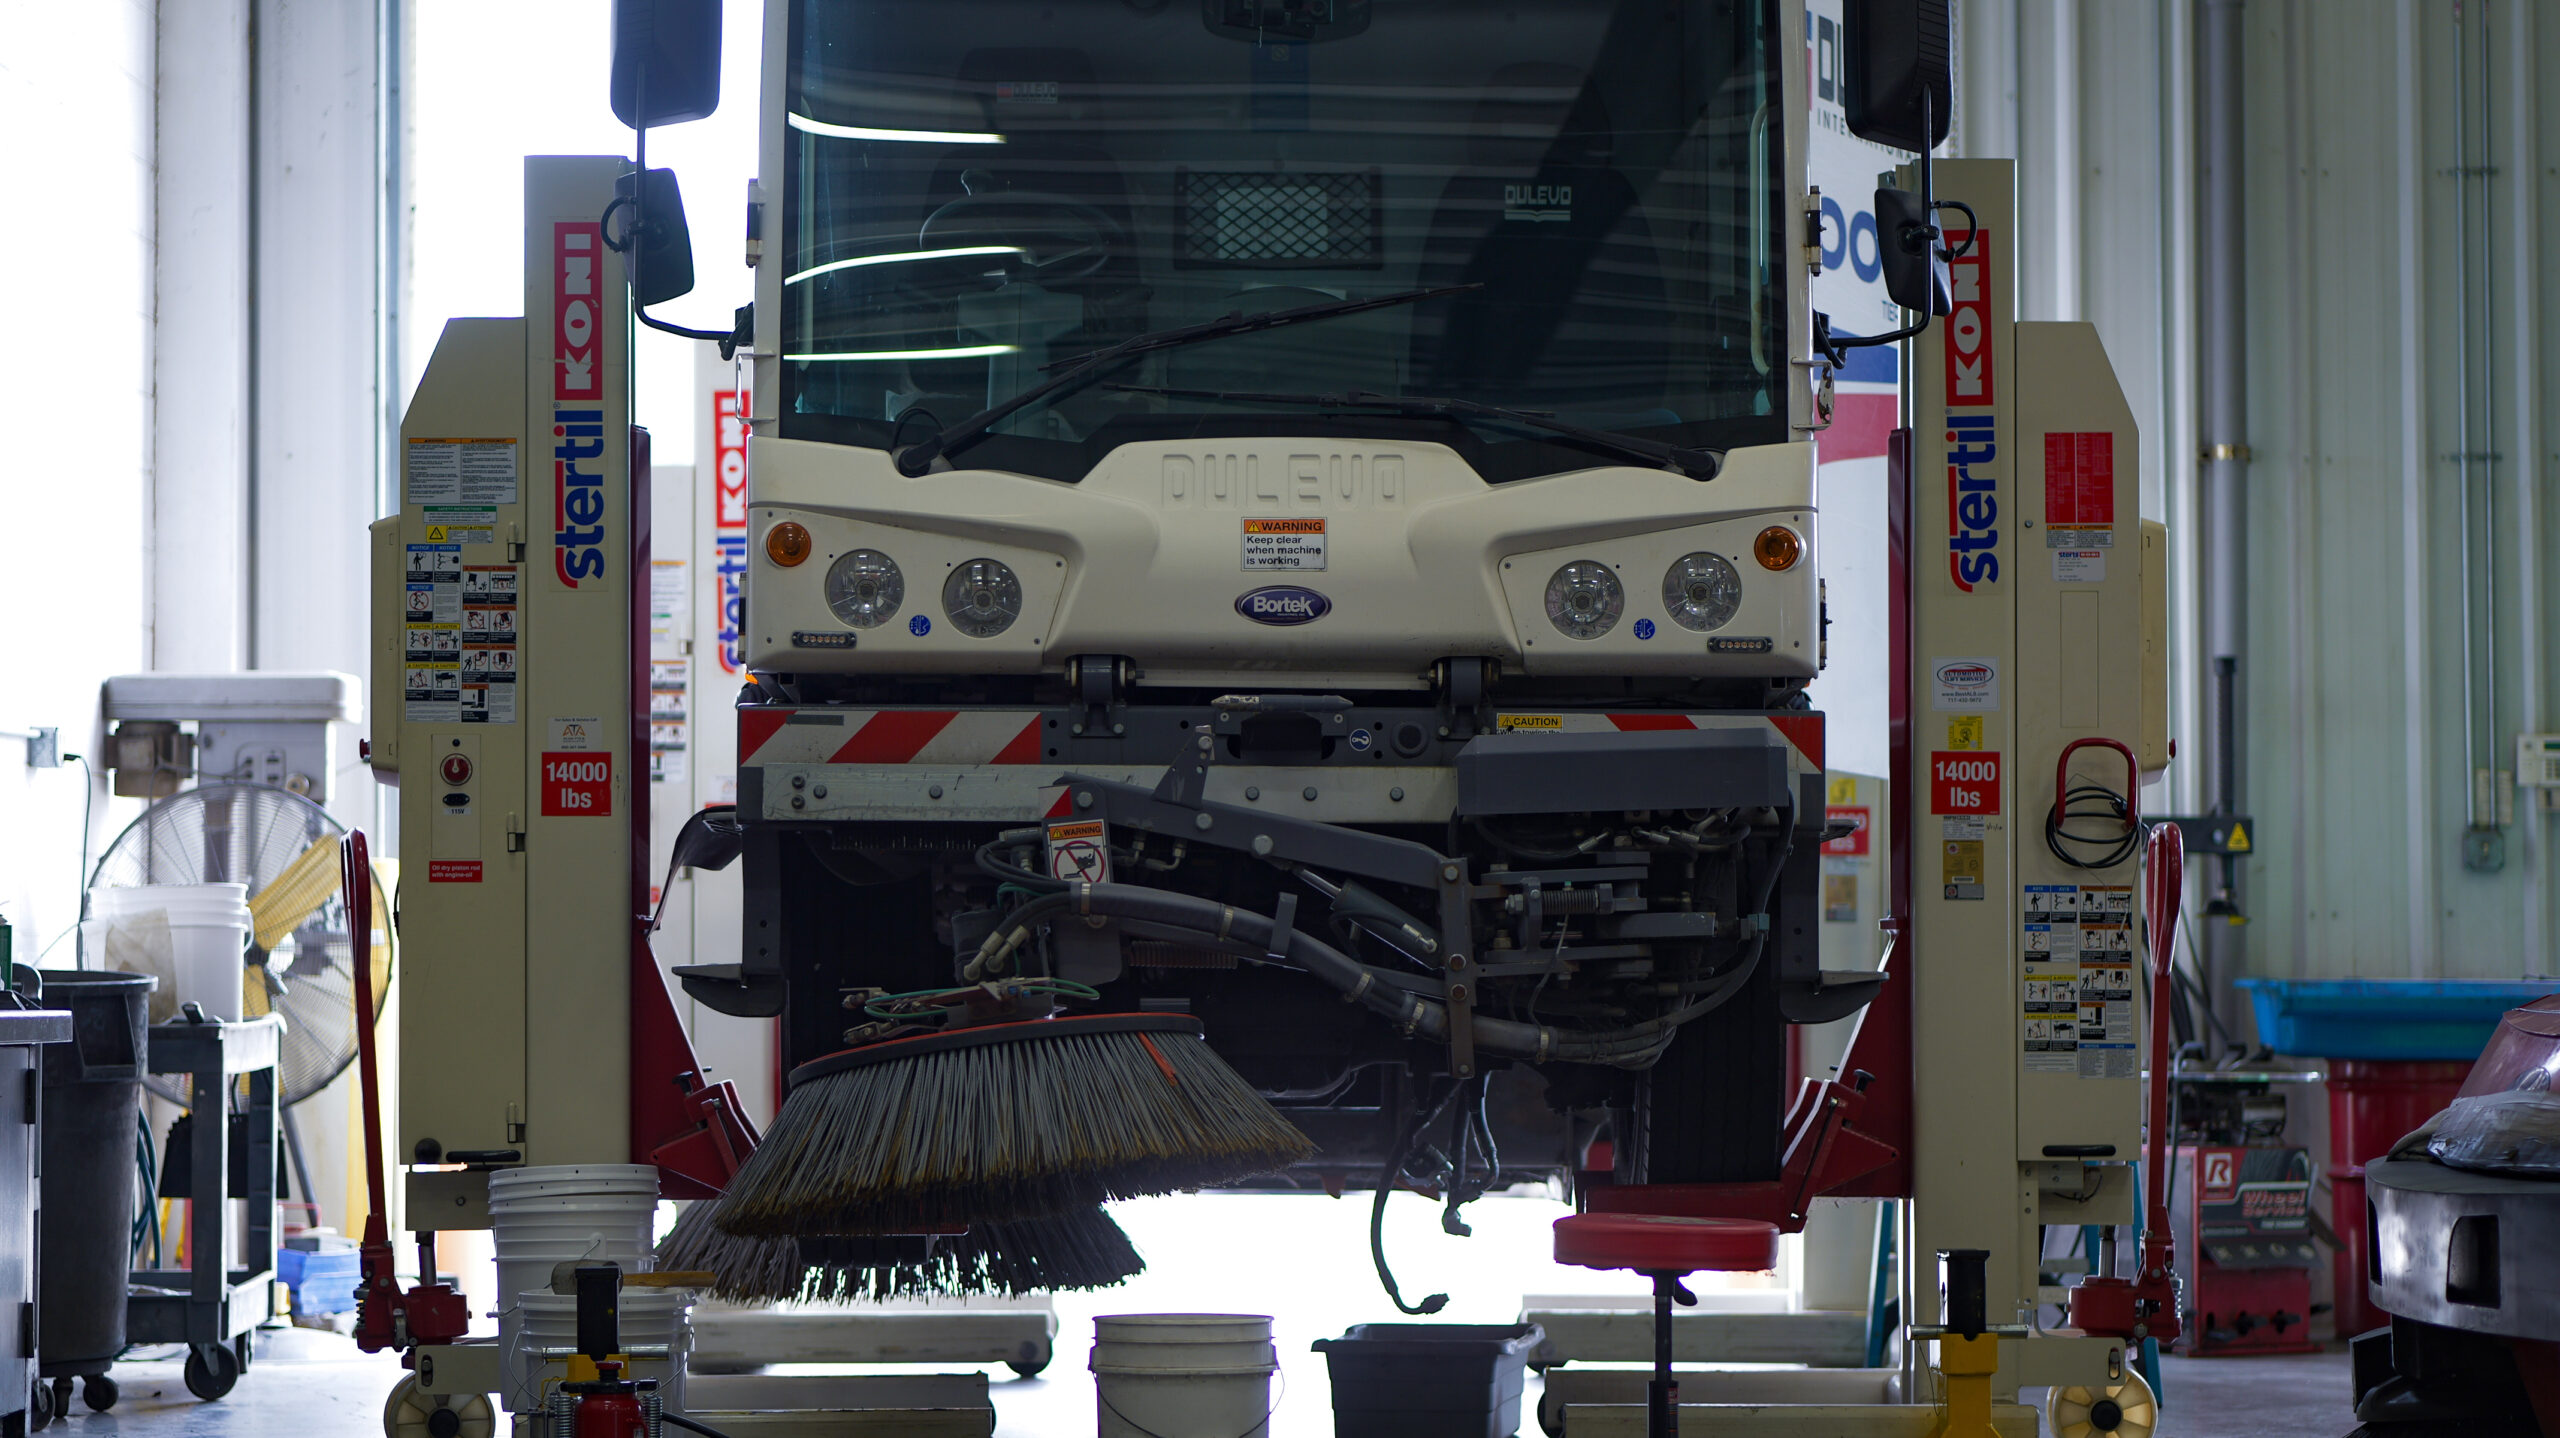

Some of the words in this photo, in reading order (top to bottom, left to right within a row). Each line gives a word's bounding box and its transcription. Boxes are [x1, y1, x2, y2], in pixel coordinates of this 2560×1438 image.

[1505, 185, 1571, 205] DULEVO
[564, 233, 592, 390] KONI
[1953, 240, 1982, 396] KONI
[720, 397, 746, 521] KONI
[1162, 454, 1405, 511] DULEVO
[554, 409, 605, 589] stertil
[1946, 415, 1999, 593] stertil
[1261, 522, 1322, 531] WARNING
[1246, 535, 1274, 545] Keep
[1276, 535, 1302, 544] clear
[1246, 545, 1274, 554] when
[1277, 545, 1322, 554] machine
[1246, 556, 1256, 564] is
[1258, 556, 1300, 566] working
[1253, 596, 1315, 617] Bortek
[563, 724, 586, 736] ATA
[1513, 717, 1558, 726] CAUTION
[546, 761, 608, 782] 14000
[1936, 761, 1996, 781] 14000
[561, 788, 592, 808] lbs
[1950, 787, 1981, 808] lbs
[1063, 826, 1101, 837] WARNING
[451, 864, 469, 872] piston
[2207, 1159, 2230, 1183] R
[2243, 1190, 2306, 1204] Wheel
[2242, 1205, 2306, 1218] Service
